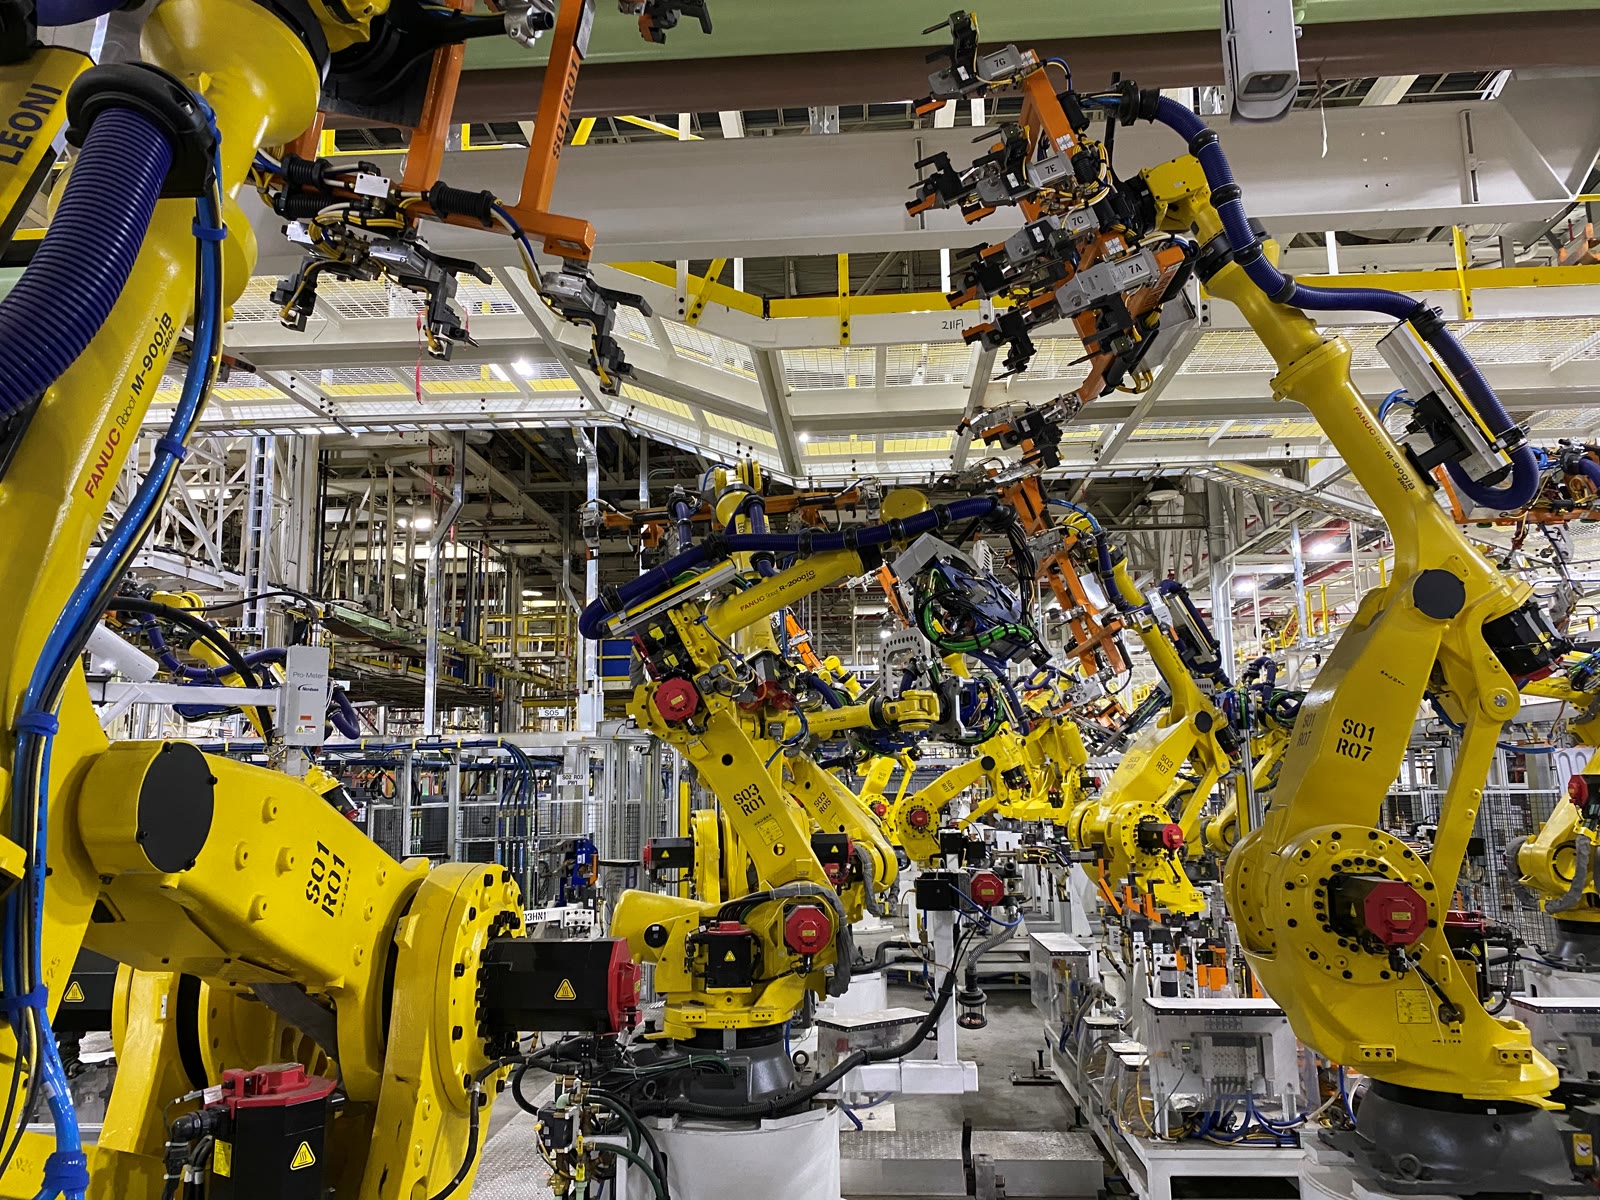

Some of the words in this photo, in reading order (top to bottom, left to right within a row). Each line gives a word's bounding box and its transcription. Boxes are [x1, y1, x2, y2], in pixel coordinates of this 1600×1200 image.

[0, 83, 63, 166] LEONI
[1045, 164, 1057, 175] 7E
[1072, 216, 1084, 226] 7C
[1128, 263, 1143, 274] 7A
[161, 326, 177, 356] 280L
[84, 427, 121, 499] FANUC
[116, 395, 138, 430] Robot
[130, 312, 173, 396] M-900iB
[1353, 406, 1376, 436] FANUC
[1384, 450, 1416, 490] M-900iB
[740, 595, 766, 612] FANUC
[779, 569, 815, 592] R-2000iC
[293, 671, 324, 679] Pro-Meter
[1341, 718, 1375, 742] S01
[1160, 754, 1174, 768] S03
[1335, 737, 1373, 762] R07
[733, 783, 760, 806] S03
[741, 794, 766, 816] R01
[813, 792, 827, 808] S03
[306, 840, 330, 904] S01
[321, 853, 345, 918] R01
